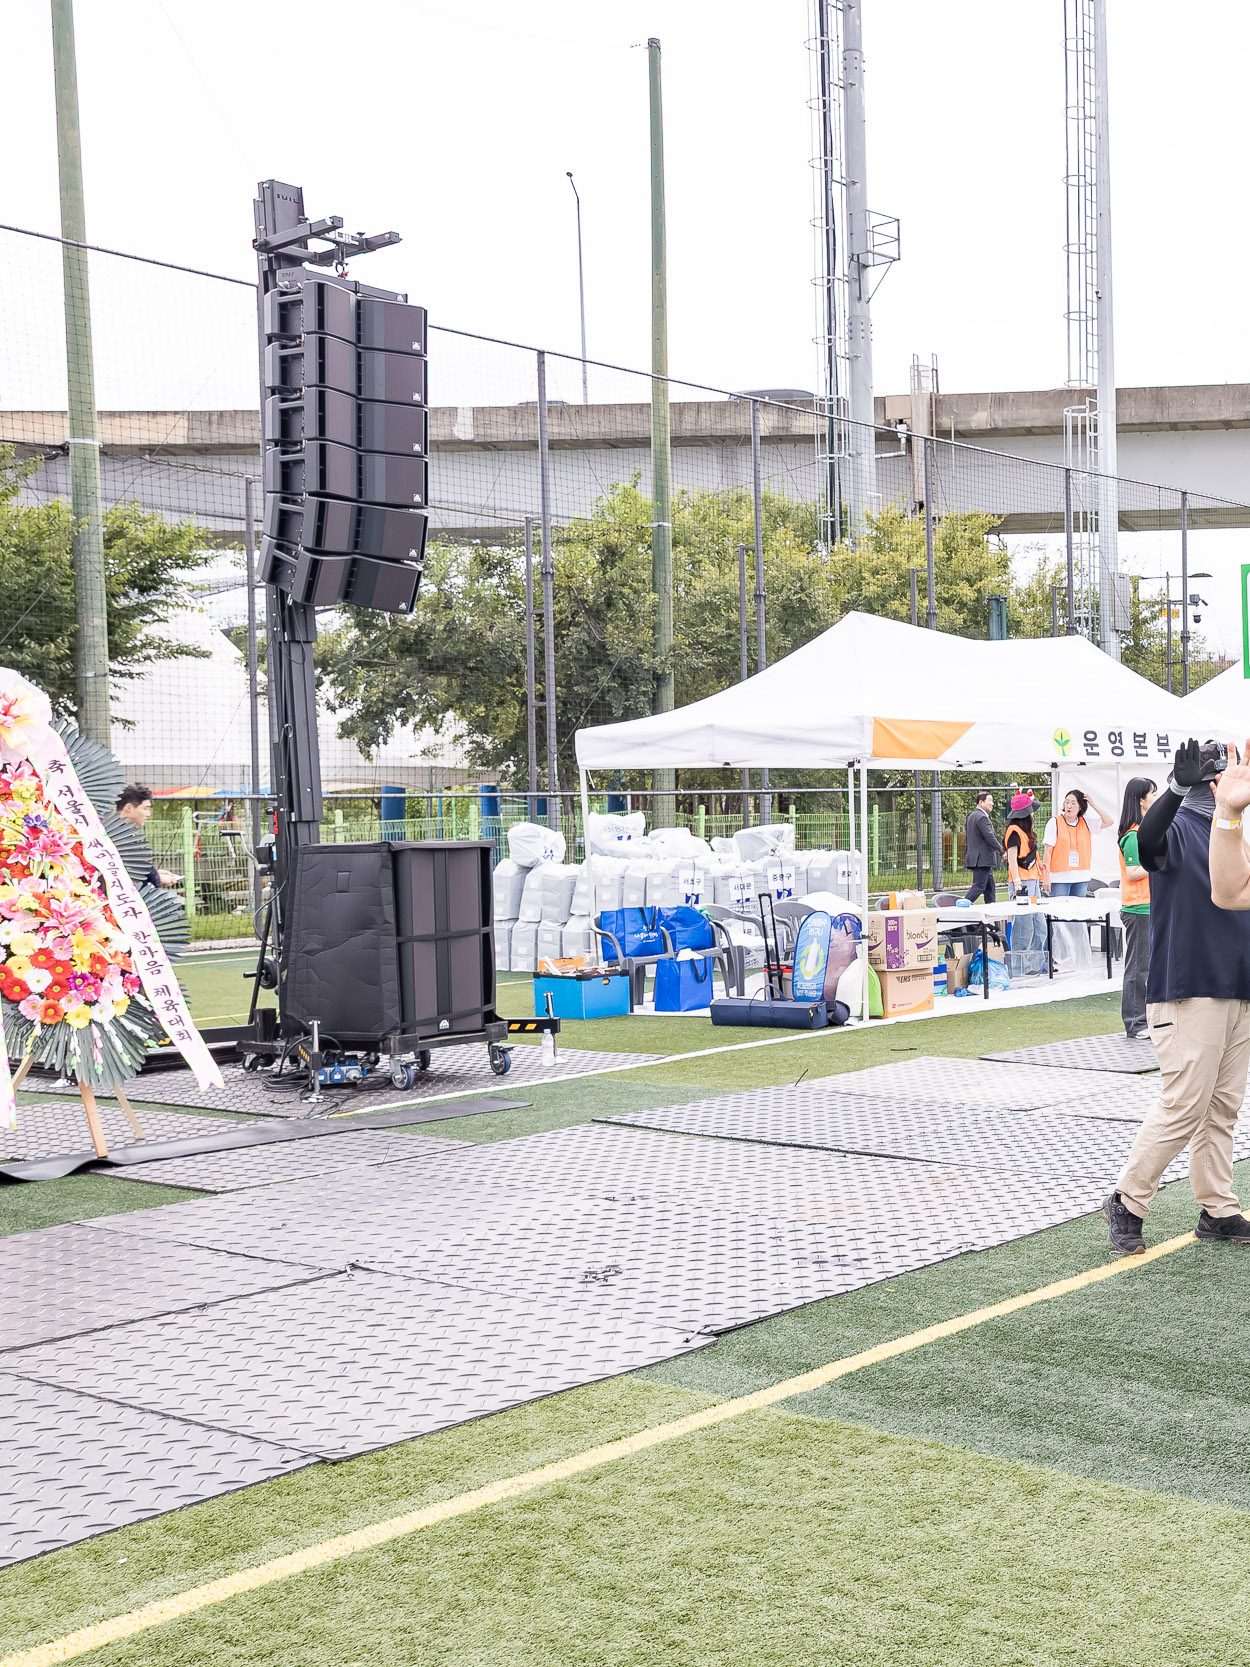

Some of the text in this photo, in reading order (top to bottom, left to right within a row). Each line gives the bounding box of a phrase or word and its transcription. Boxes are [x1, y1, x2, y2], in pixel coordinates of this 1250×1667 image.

[48, 760, 193, 1041] 축 서울시 새마을지도자 한마음 체육대회
[734, 882, 752, 892] 서대문
